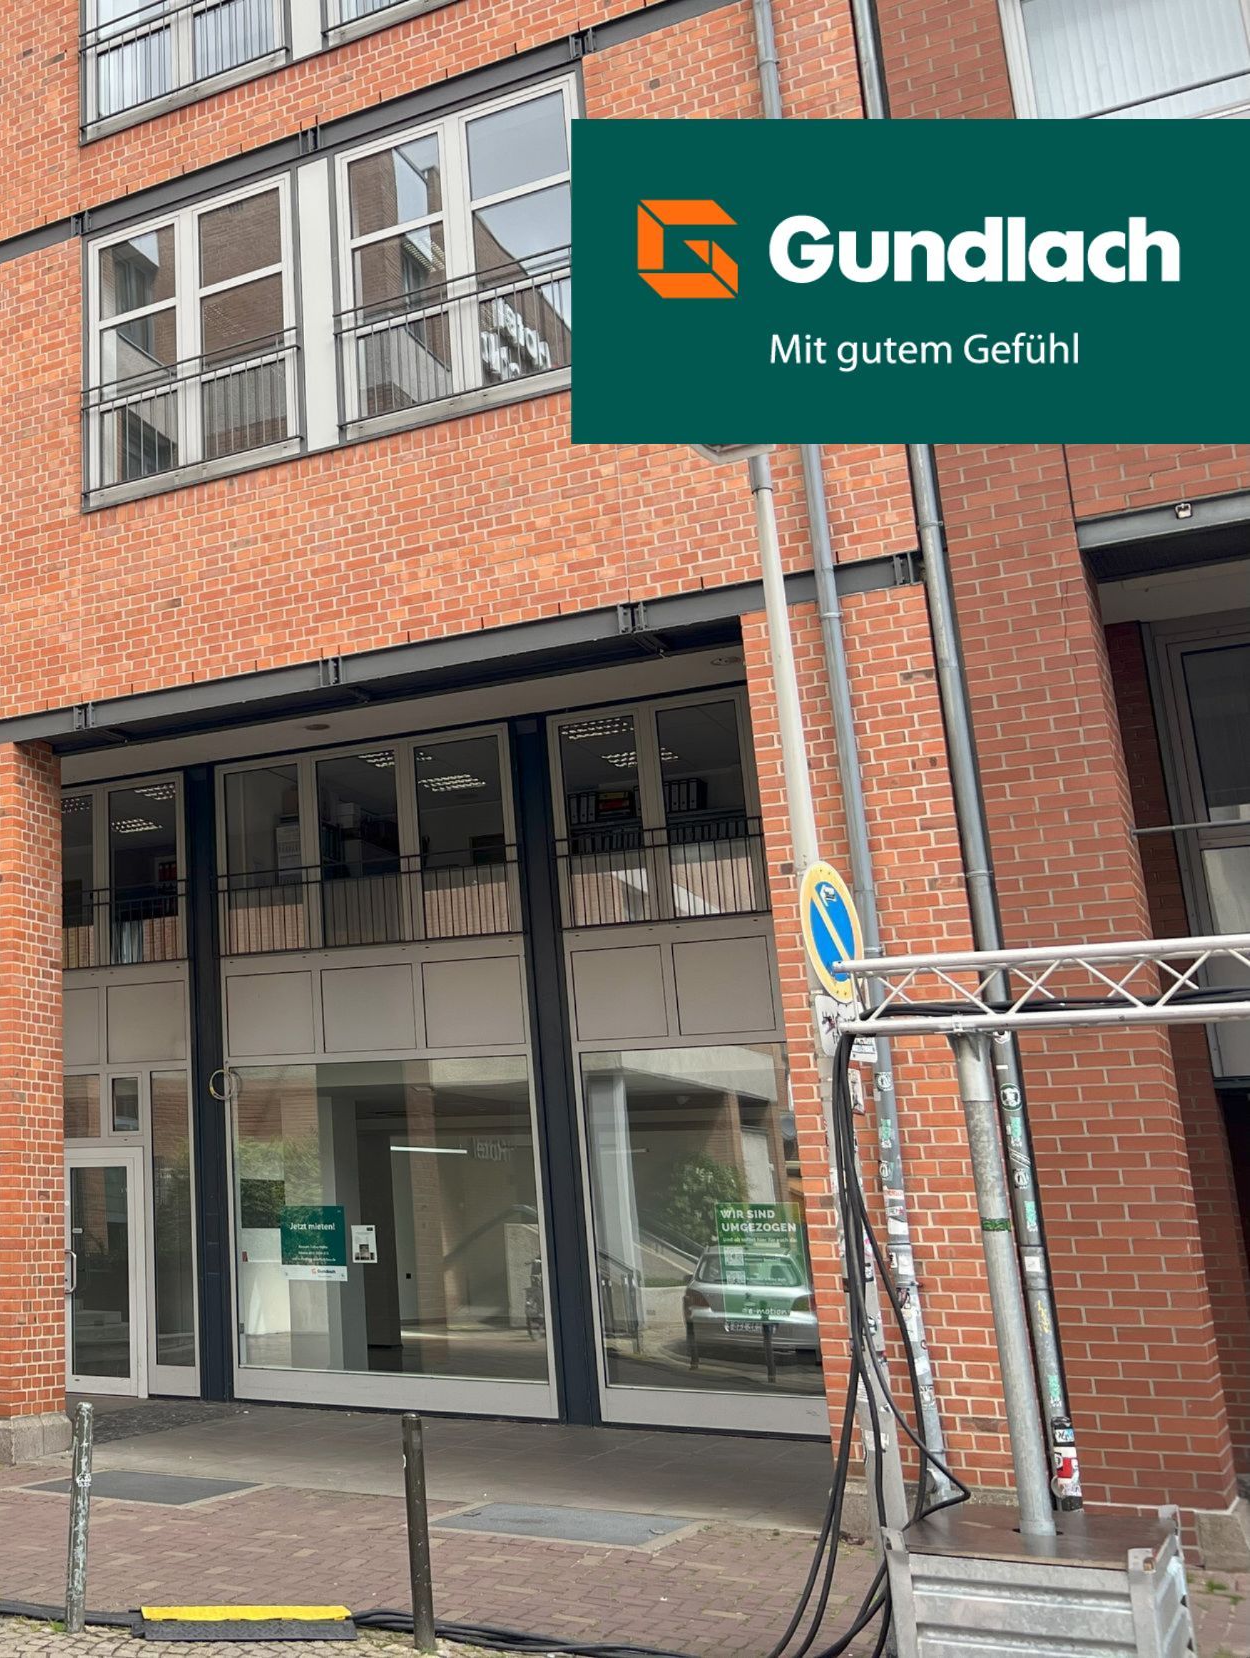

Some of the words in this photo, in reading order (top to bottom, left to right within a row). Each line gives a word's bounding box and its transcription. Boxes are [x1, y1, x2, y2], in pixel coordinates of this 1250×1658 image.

[720, 1209, 744, 1219] WIR
[747, 1209, 775, 1219] SIND
[290, 1222, 306, 1230] Jetzt
[308, 1222, 335, 1230] mieten!
[721, 1222, 797, 1232] UMGEZOGEN
